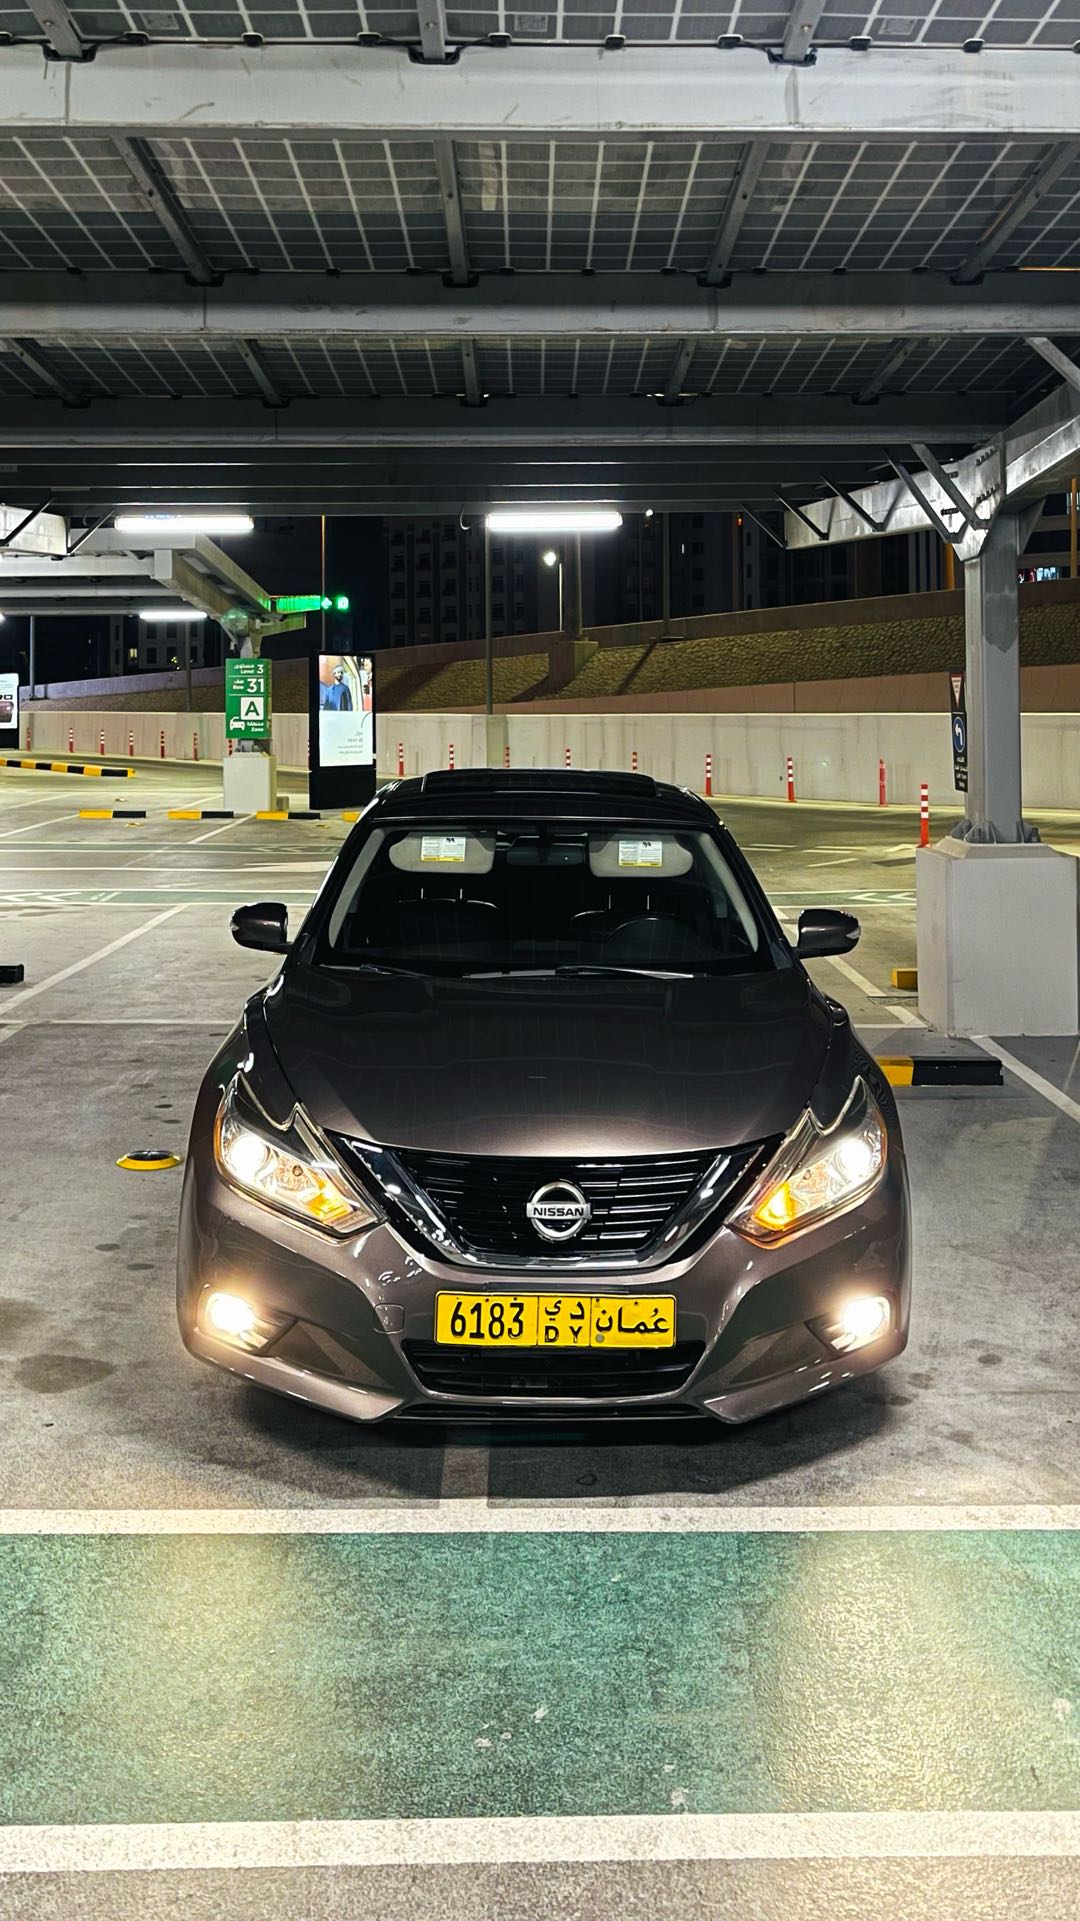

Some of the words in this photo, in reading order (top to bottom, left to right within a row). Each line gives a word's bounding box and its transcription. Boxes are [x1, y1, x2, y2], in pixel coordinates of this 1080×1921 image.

[256, 664, 264, 674] 3
[246, 678, 264, 693] 31
[244, 701, 260, 717] A
[533, 1207, 584, 1217] NISSAN
[450, 1301, 525, 1339] 6183
